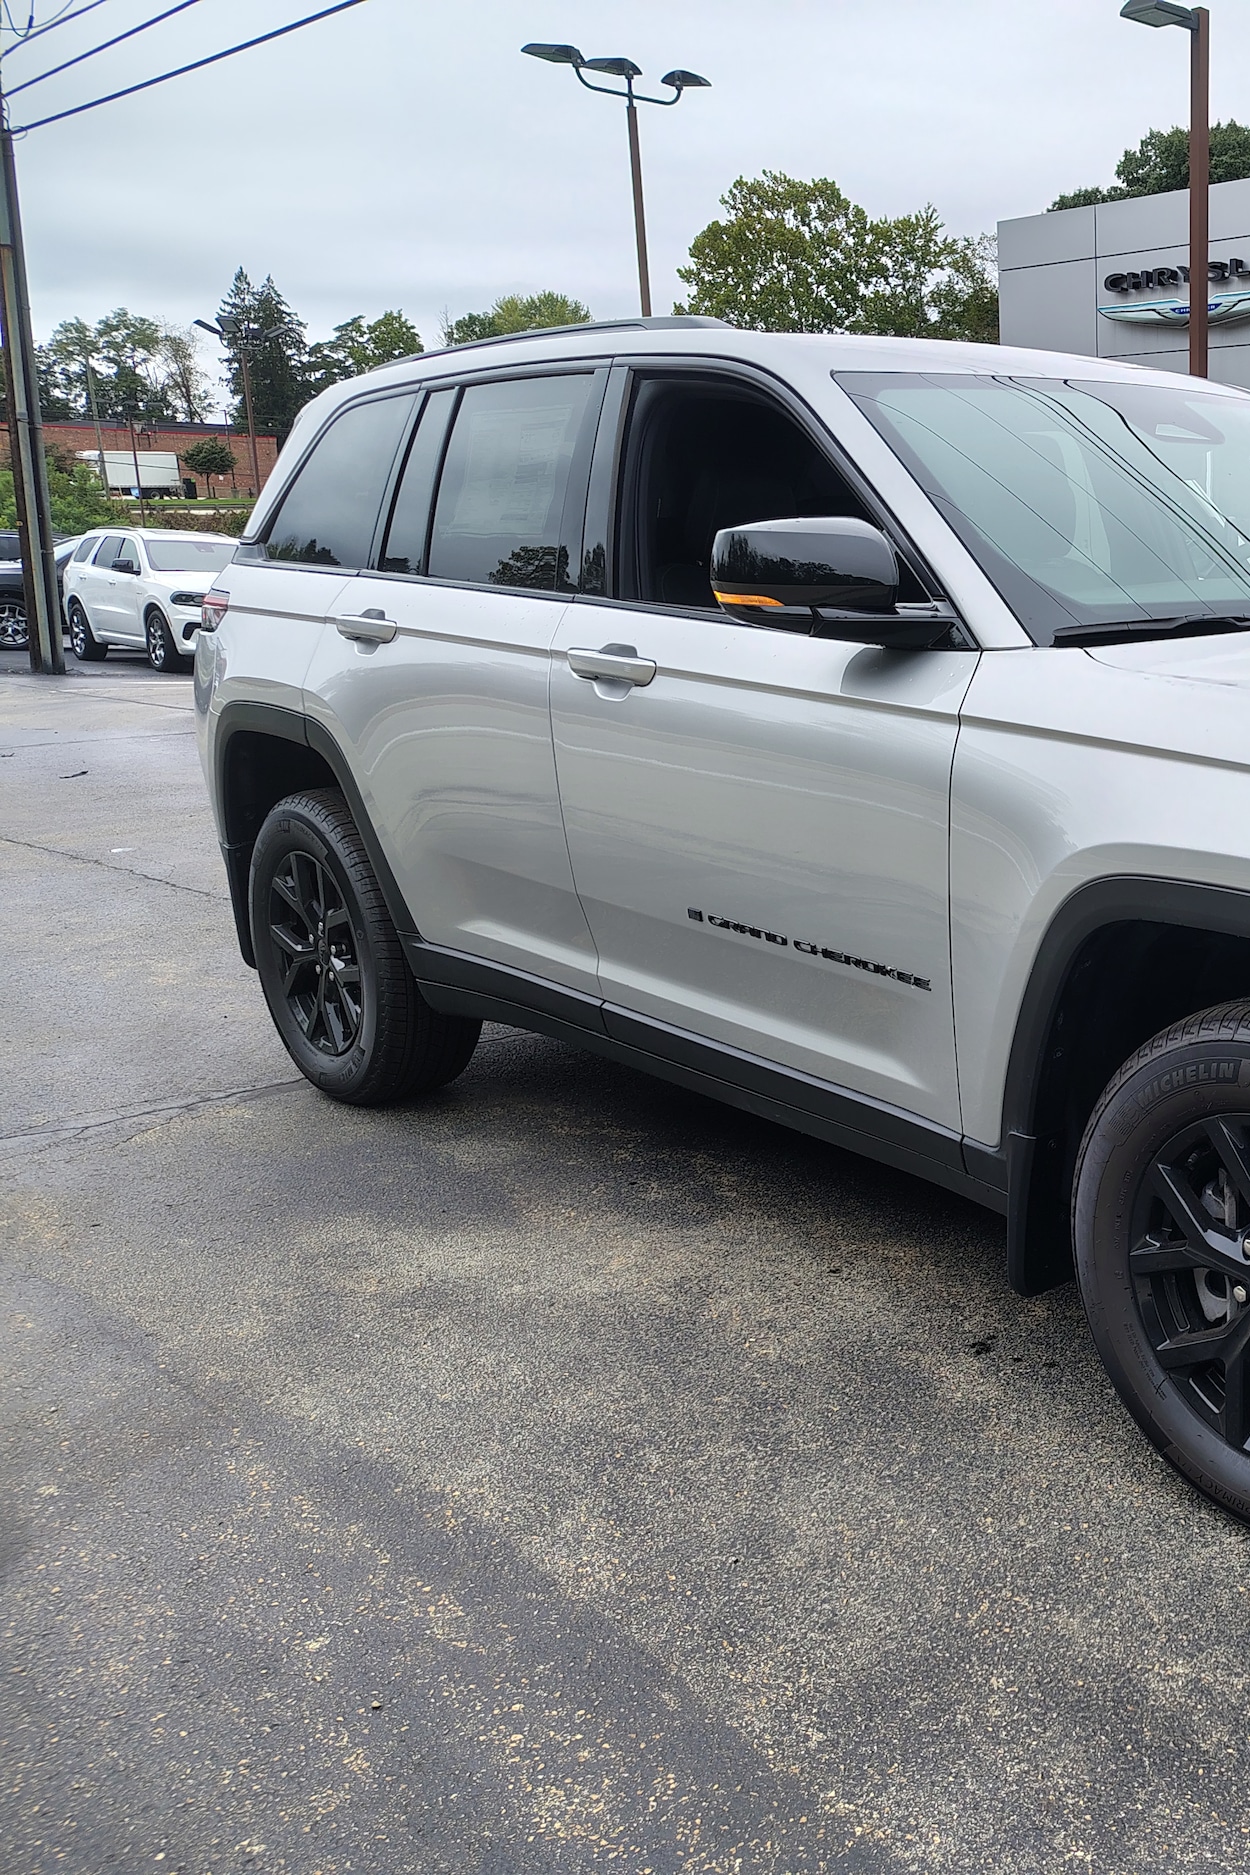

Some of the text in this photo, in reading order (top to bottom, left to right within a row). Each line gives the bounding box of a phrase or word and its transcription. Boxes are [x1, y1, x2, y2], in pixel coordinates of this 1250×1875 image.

[707, 913, 932, 992] GRAND CHEROKEE
[1136, 1062, 1235, 1107] MICHELIN
